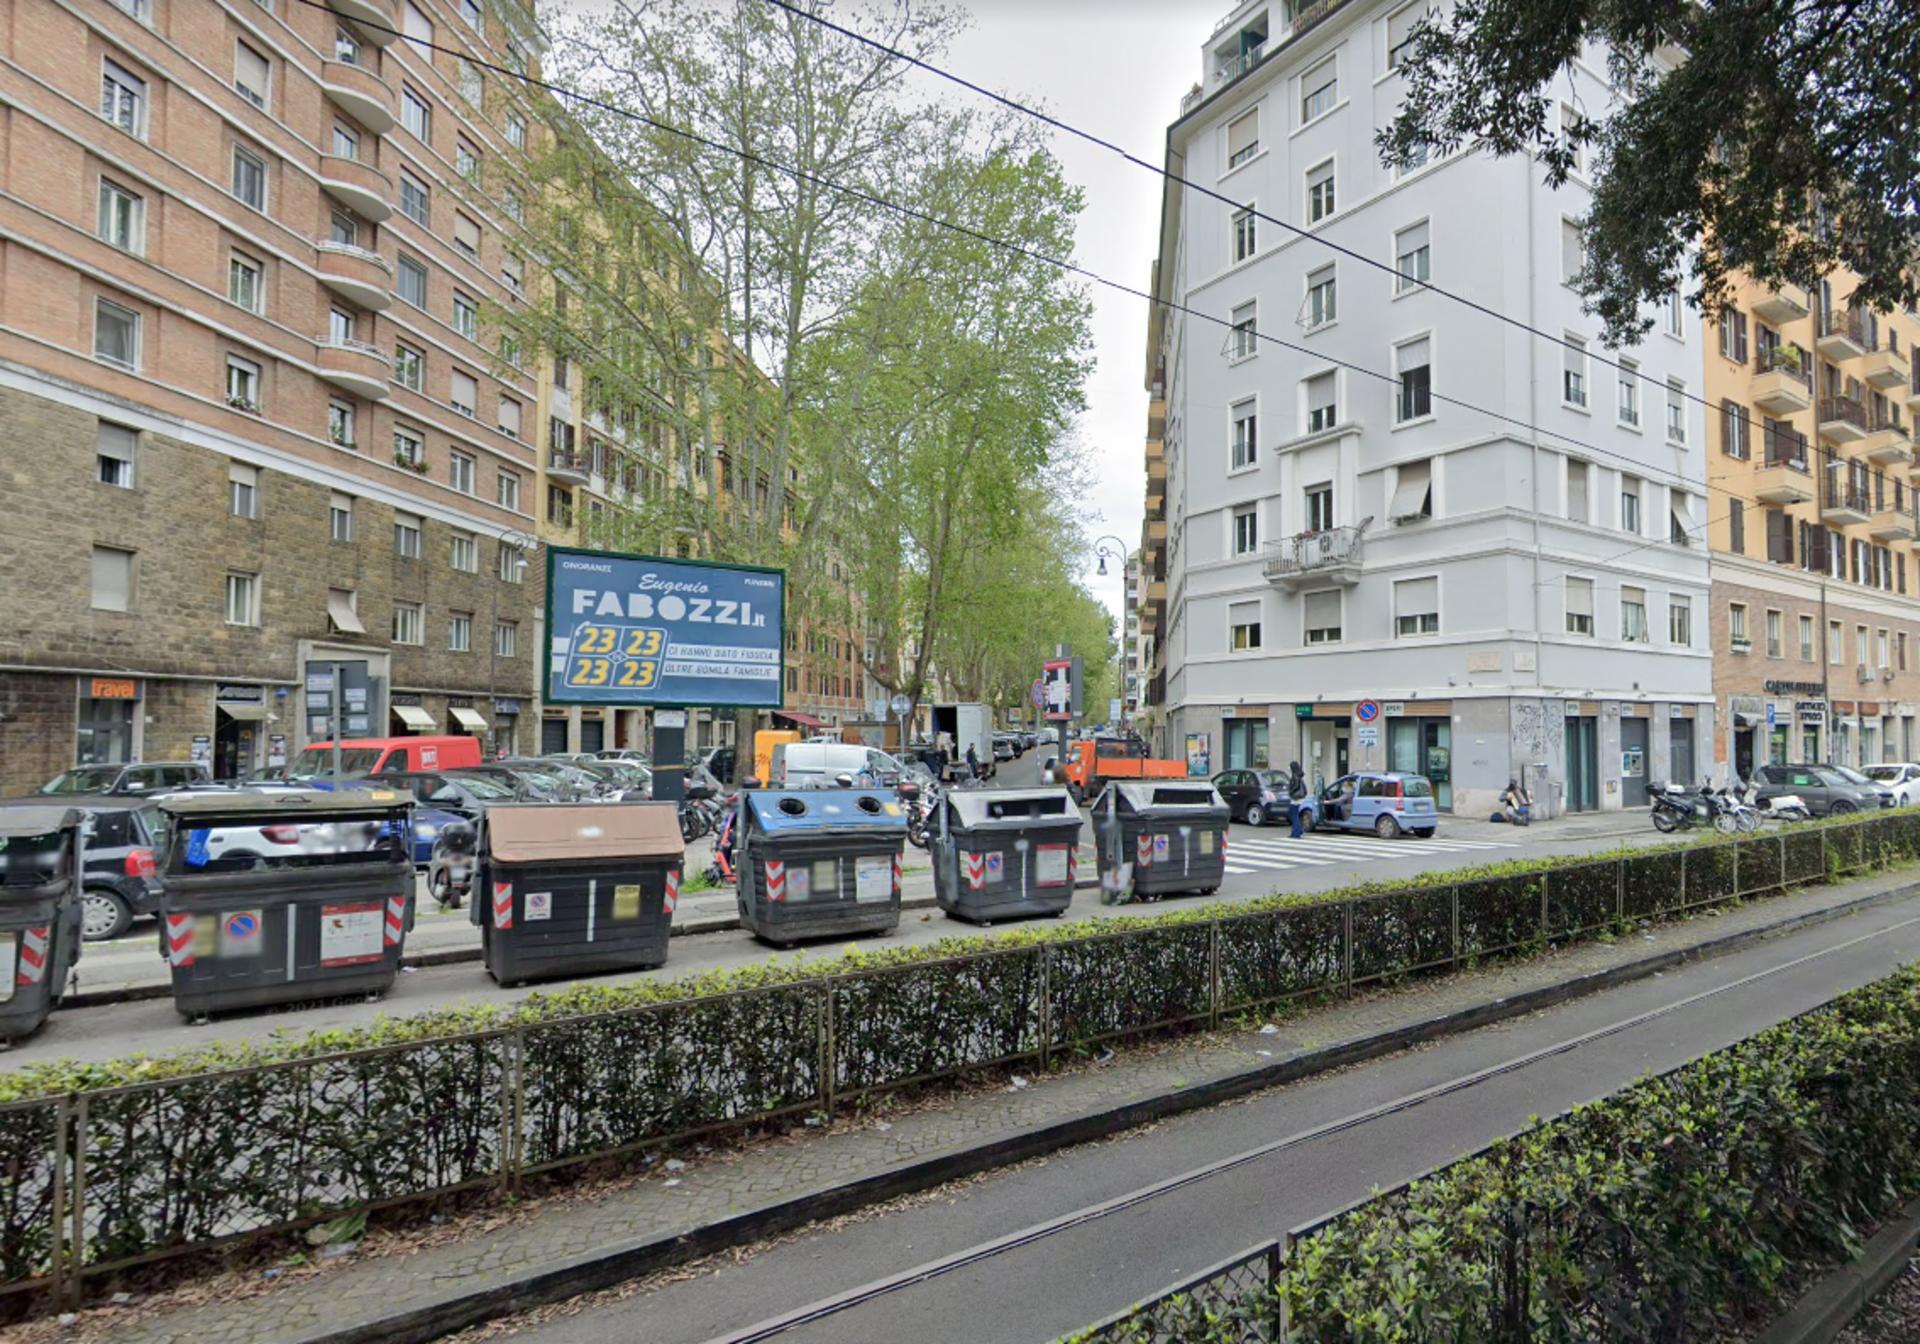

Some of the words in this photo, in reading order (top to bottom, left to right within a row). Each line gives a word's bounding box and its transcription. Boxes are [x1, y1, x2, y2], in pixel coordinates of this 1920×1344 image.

[563, 561, 612, 573] ONORANZE
[638, 573, 709, 595] Eugenio
[578, 627, 616, 653] 23
[626, 630, 662, 656] 23
[668, 646, 678, 656] CI
[680, 646, 712, 658] HANNO
[714, 648, 737, 659] DATO
[741, 650, 773, 660] FIDUCIA
[571, 658, 609, 685] 23
[618, 660, 656, 687] 23
[665, 664, 693, 674] OLTRE
[734, 667, 772, 677] FAMIGLIE
[91, 678, 135, 698] travel
